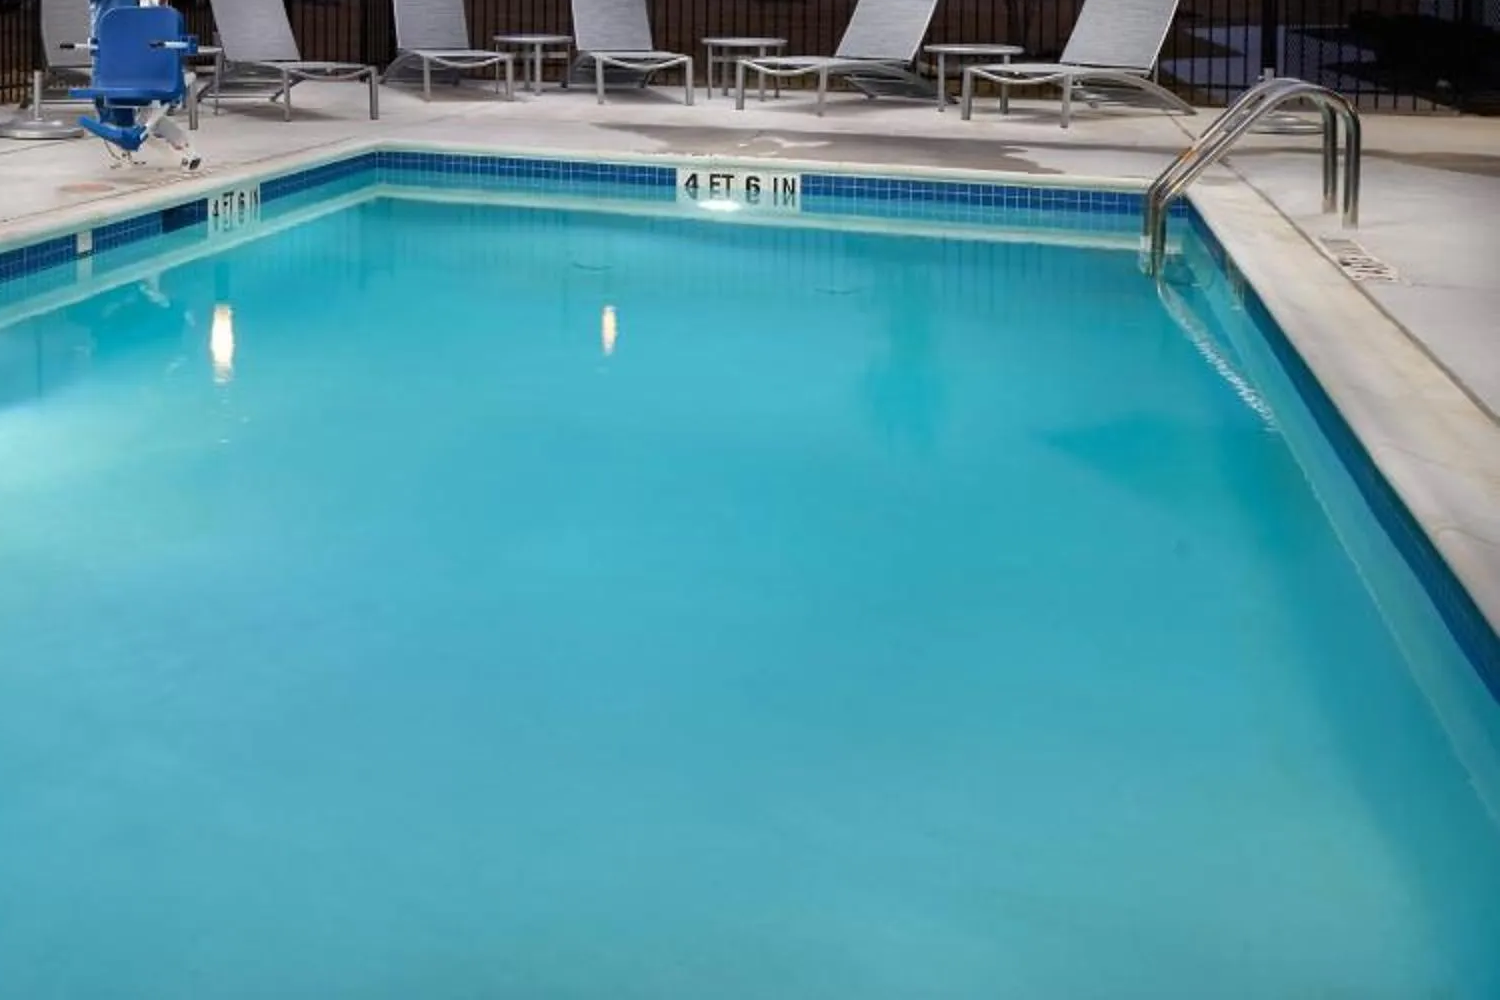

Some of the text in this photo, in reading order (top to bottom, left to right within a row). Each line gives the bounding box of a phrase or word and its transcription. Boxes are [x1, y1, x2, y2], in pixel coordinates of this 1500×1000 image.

[684, 173, 796, 197] 4 FT 6 IN
